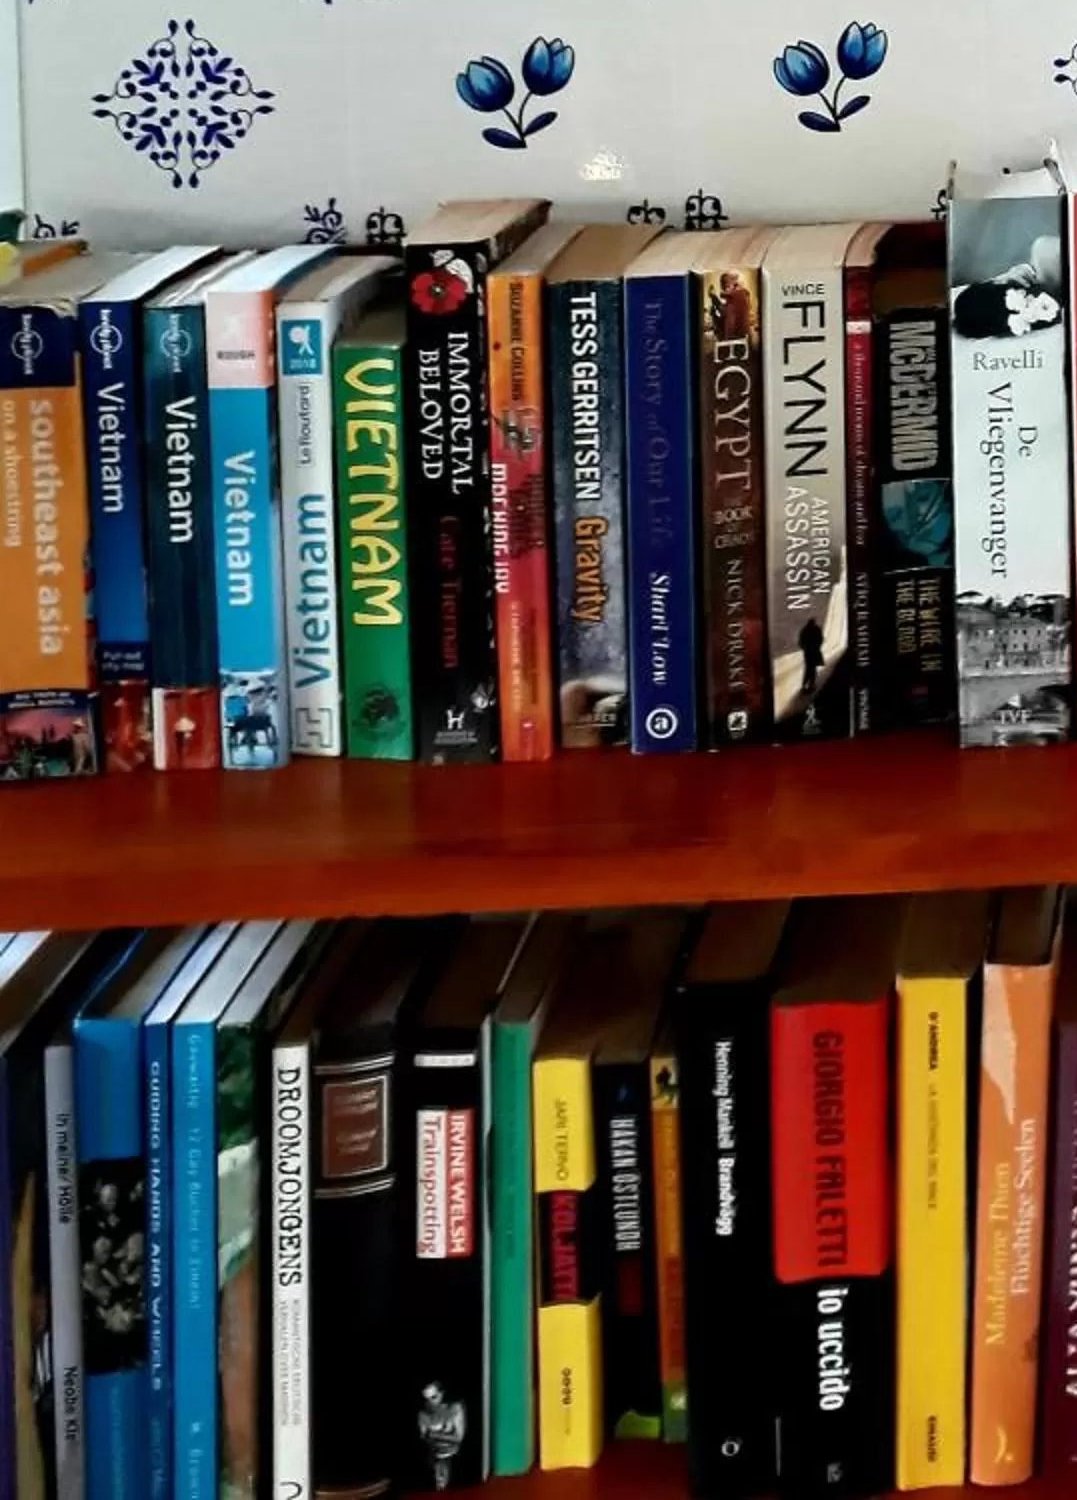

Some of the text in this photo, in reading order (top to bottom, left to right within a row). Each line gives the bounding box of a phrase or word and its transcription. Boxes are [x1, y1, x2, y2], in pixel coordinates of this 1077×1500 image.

[781, 281, 825, 297] VINCE
[418, 349, 444, 480] BELOVED
[446, 331, 475, 494] IMMORTAL
[571, 292, 602, 500] TESS GERRITSEN
[713, 336, 752, 491] EGYPT
[783, 300, 828, 477] FLYNN
[973, 349, 1044, 373] Ravelli
[2, 445, 23, 547] shoestring
[29, 399, 63, 576] southeast
[96, 382, 126, 513] Vietnam
[164, 397, 197, 544] Vietnam
[344, 359, 402, 625] VIETNAM
[979, 381, 1014, 579] Vliegenvanger
[1016, 424, 1038, 458] De
[223, 450, 256, 606] Vietnam
[294, 493, 331, 688] Vietnam
[573, 517, 607, 624] Gravity
[725, 559, 745, 615] NICK
[786, 485, 811, 611] ASSASSIN
[811, 497, 831, 595] AMERICAN
[38, 586, 70, 655] asia
[712, 1041, 734, 1097] Henning
[150, 1157, 163, 1234] HANDS
[275, 1067, 303, 1287] DROOMJONGENS
[418, 1115, 443, 1254] Trainspotting
[450, 1114, 467, 1253] IRVINE WELSH
[715, 1157, 736, 1236] Brandvägg
[812, 1030, 849, 1268] GIORGIO FALETTI
[1016, 1117, 1037, 1189] Seelen
[150, 1243, 164, 1289] AND
[817, 1288, 851, 1411] io uccido
